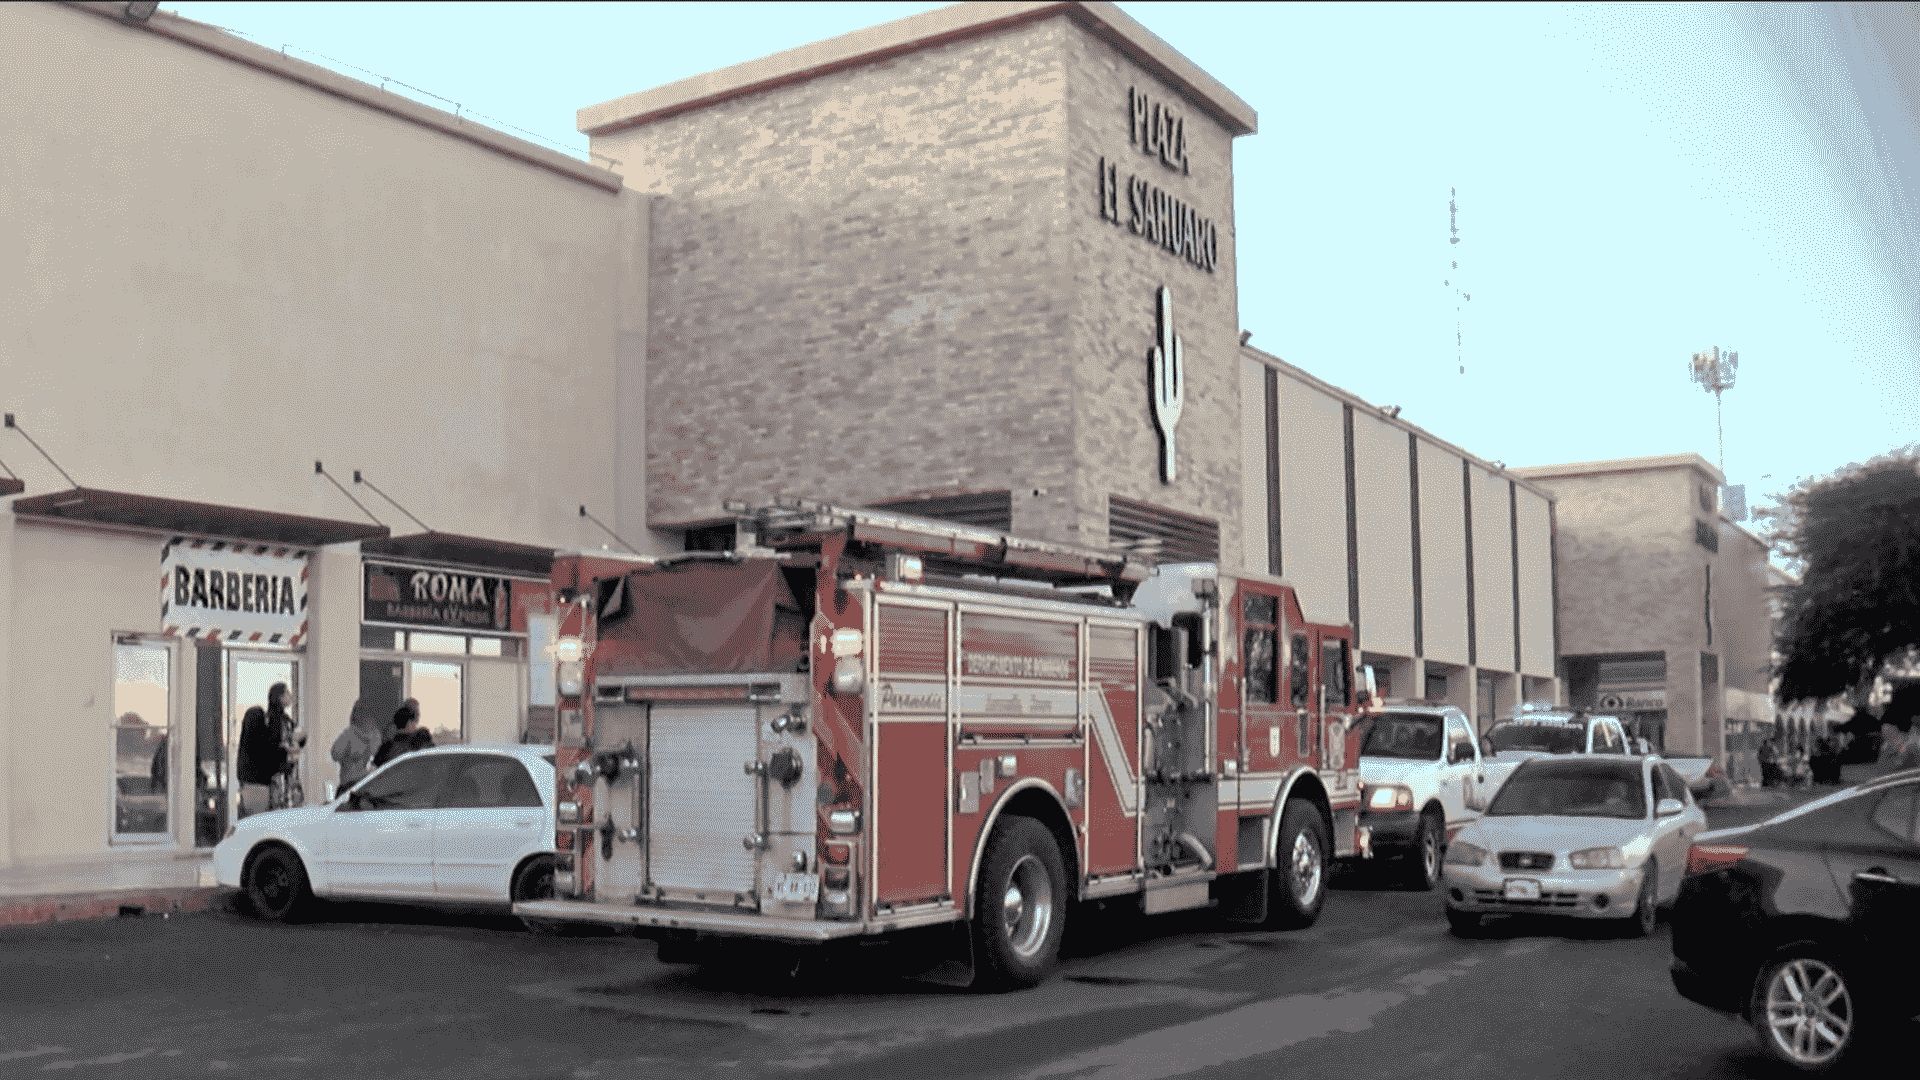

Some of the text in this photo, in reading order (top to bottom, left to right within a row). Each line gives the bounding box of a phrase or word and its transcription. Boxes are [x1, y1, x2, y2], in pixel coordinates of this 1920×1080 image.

[1128, 86, 1189, 175] PLAZA
[1099, 156, 1216, 273] EL SAHUARO
[174, 565, 295, 615] BARBERIA
[410, 570, 488, 606] ROMA
